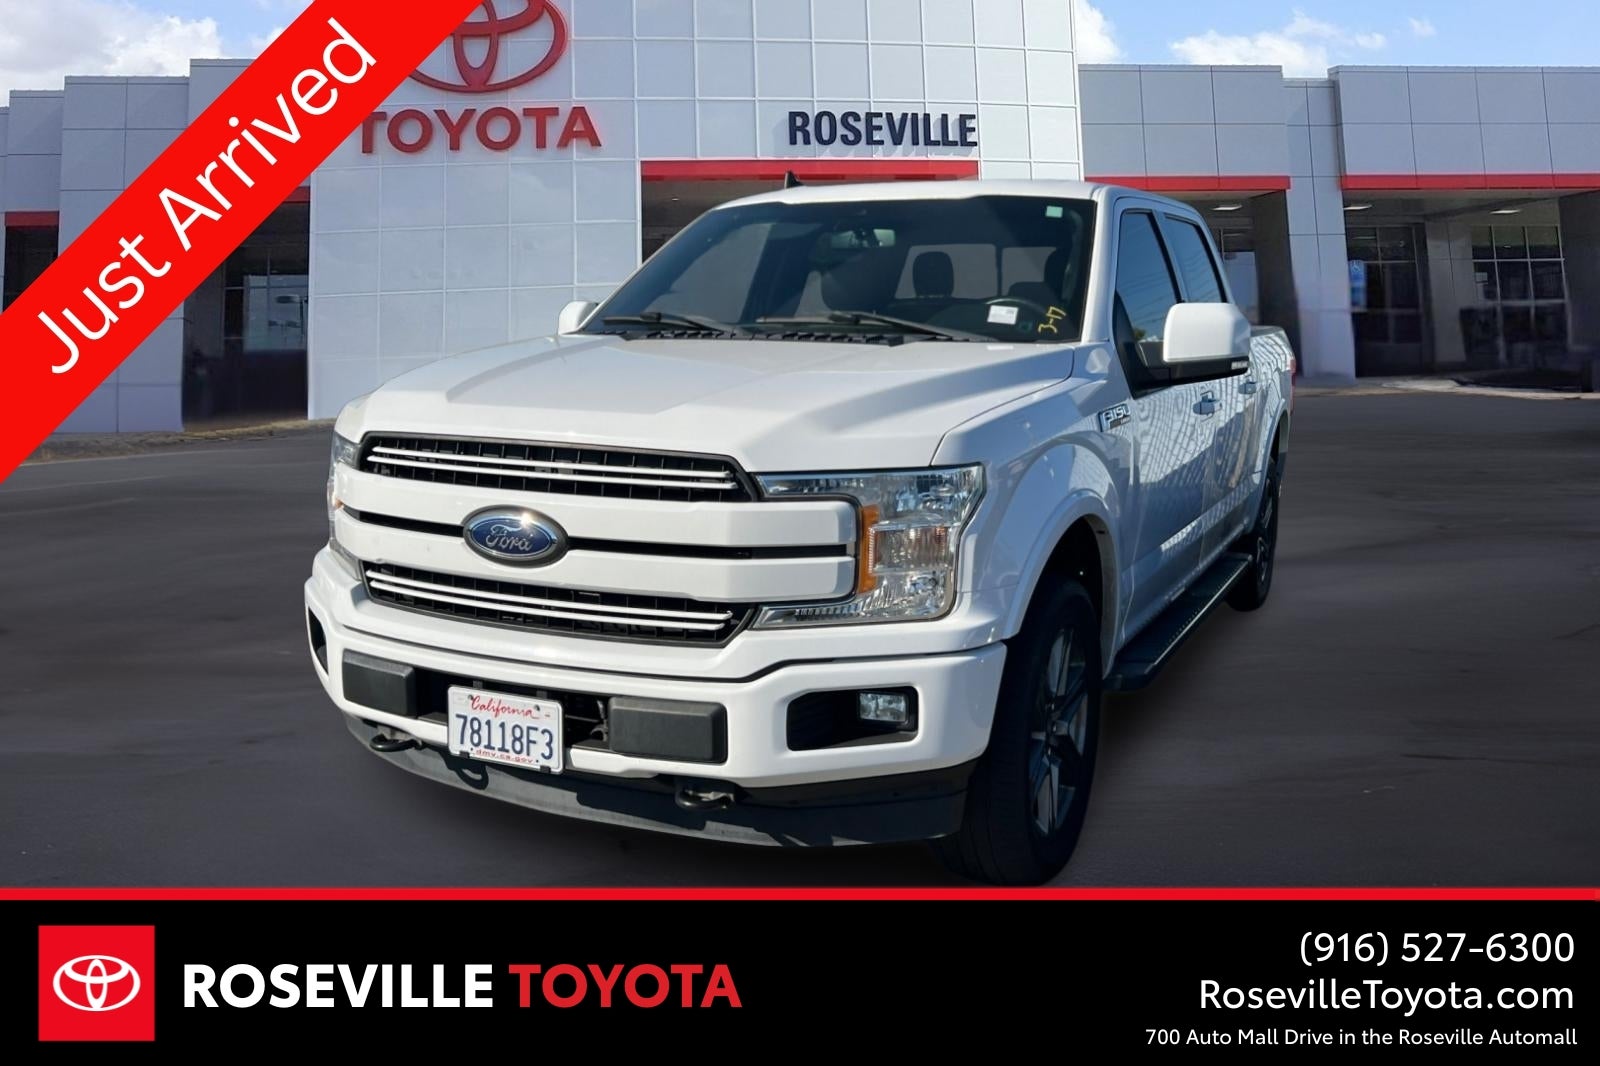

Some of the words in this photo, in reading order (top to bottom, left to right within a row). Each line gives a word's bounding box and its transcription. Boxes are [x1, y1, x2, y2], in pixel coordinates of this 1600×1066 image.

[360, 106, 602, 154] TOYOTA
[788, 111, 978, 147] ROSEVILLE
[485, 523, 534, 552] Ford
[471, 696, 540, 718] California
[455, 713, 554, 760] 78118F3
[475, 749, 535, 763] dmv.ca.gov
